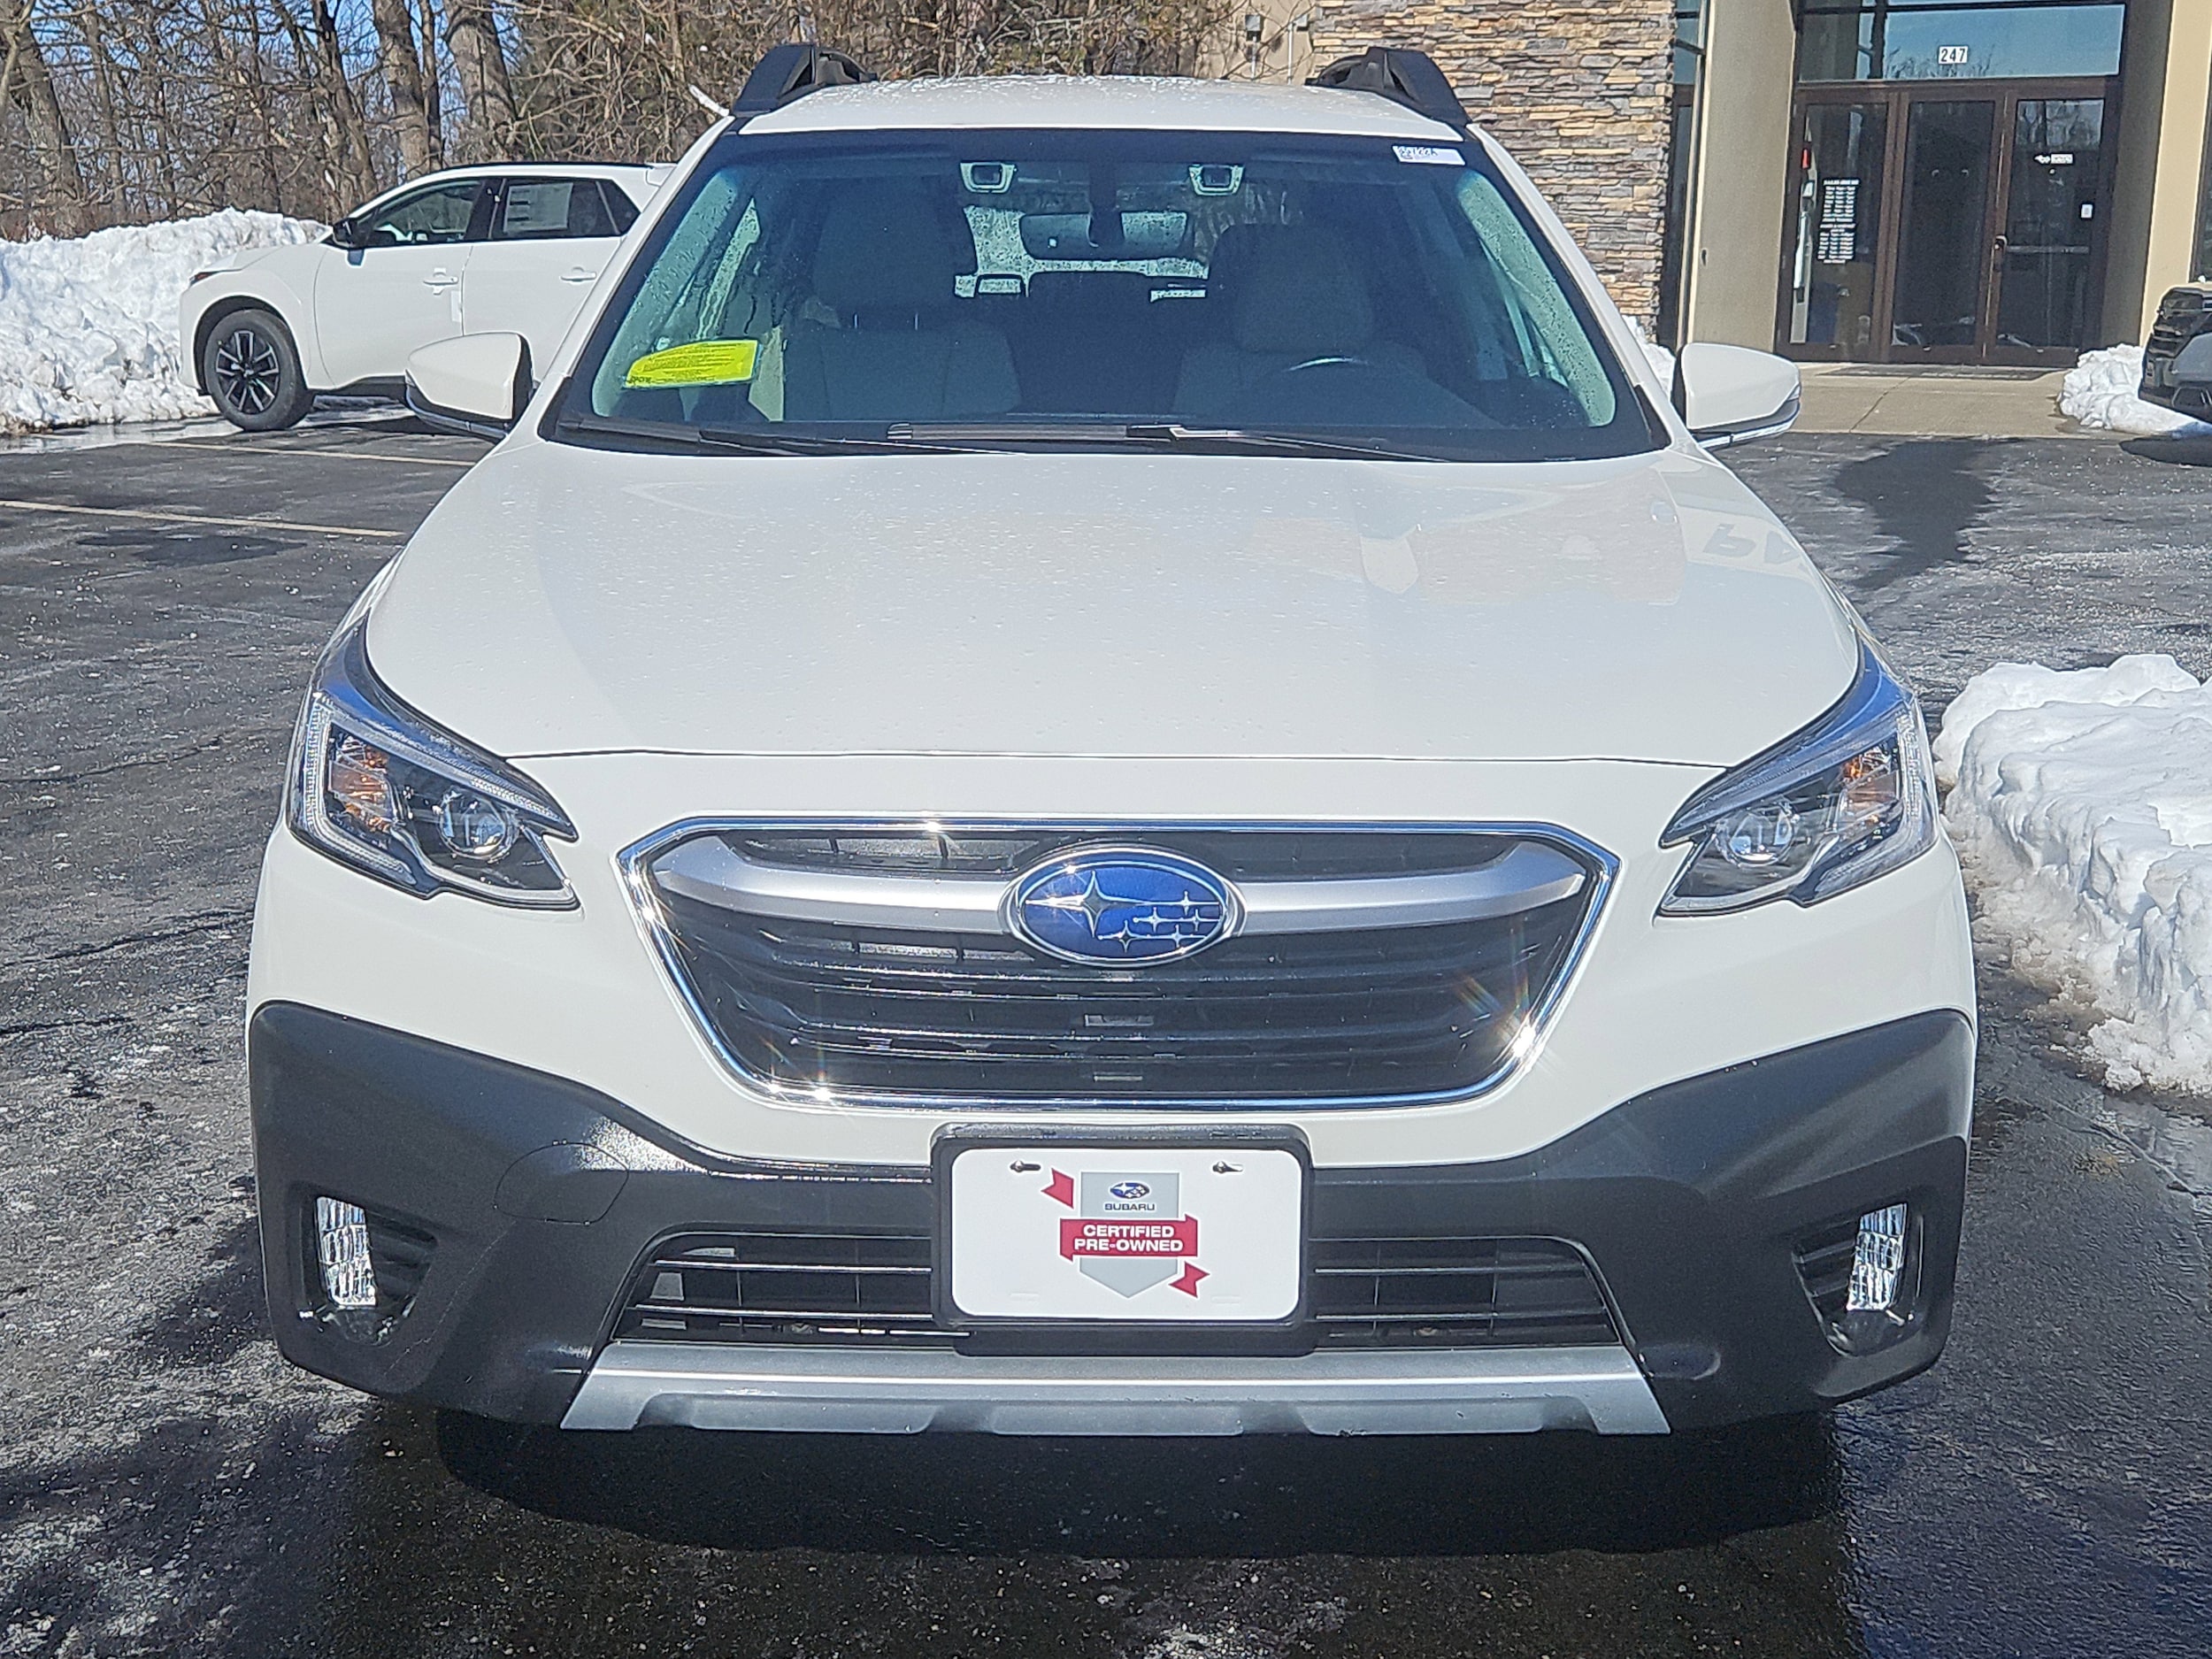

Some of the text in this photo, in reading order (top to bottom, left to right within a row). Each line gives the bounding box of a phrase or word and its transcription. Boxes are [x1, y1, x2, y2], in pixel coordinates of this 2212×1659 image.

[1940, 48, 1966, 63] 247
[1104, 1202, 1156, 1211] SUBARU
[1083, 1225, 1175, 1239] CERTIFIED
[1073, 1238, 1184, 1252] PRE-OWNED
